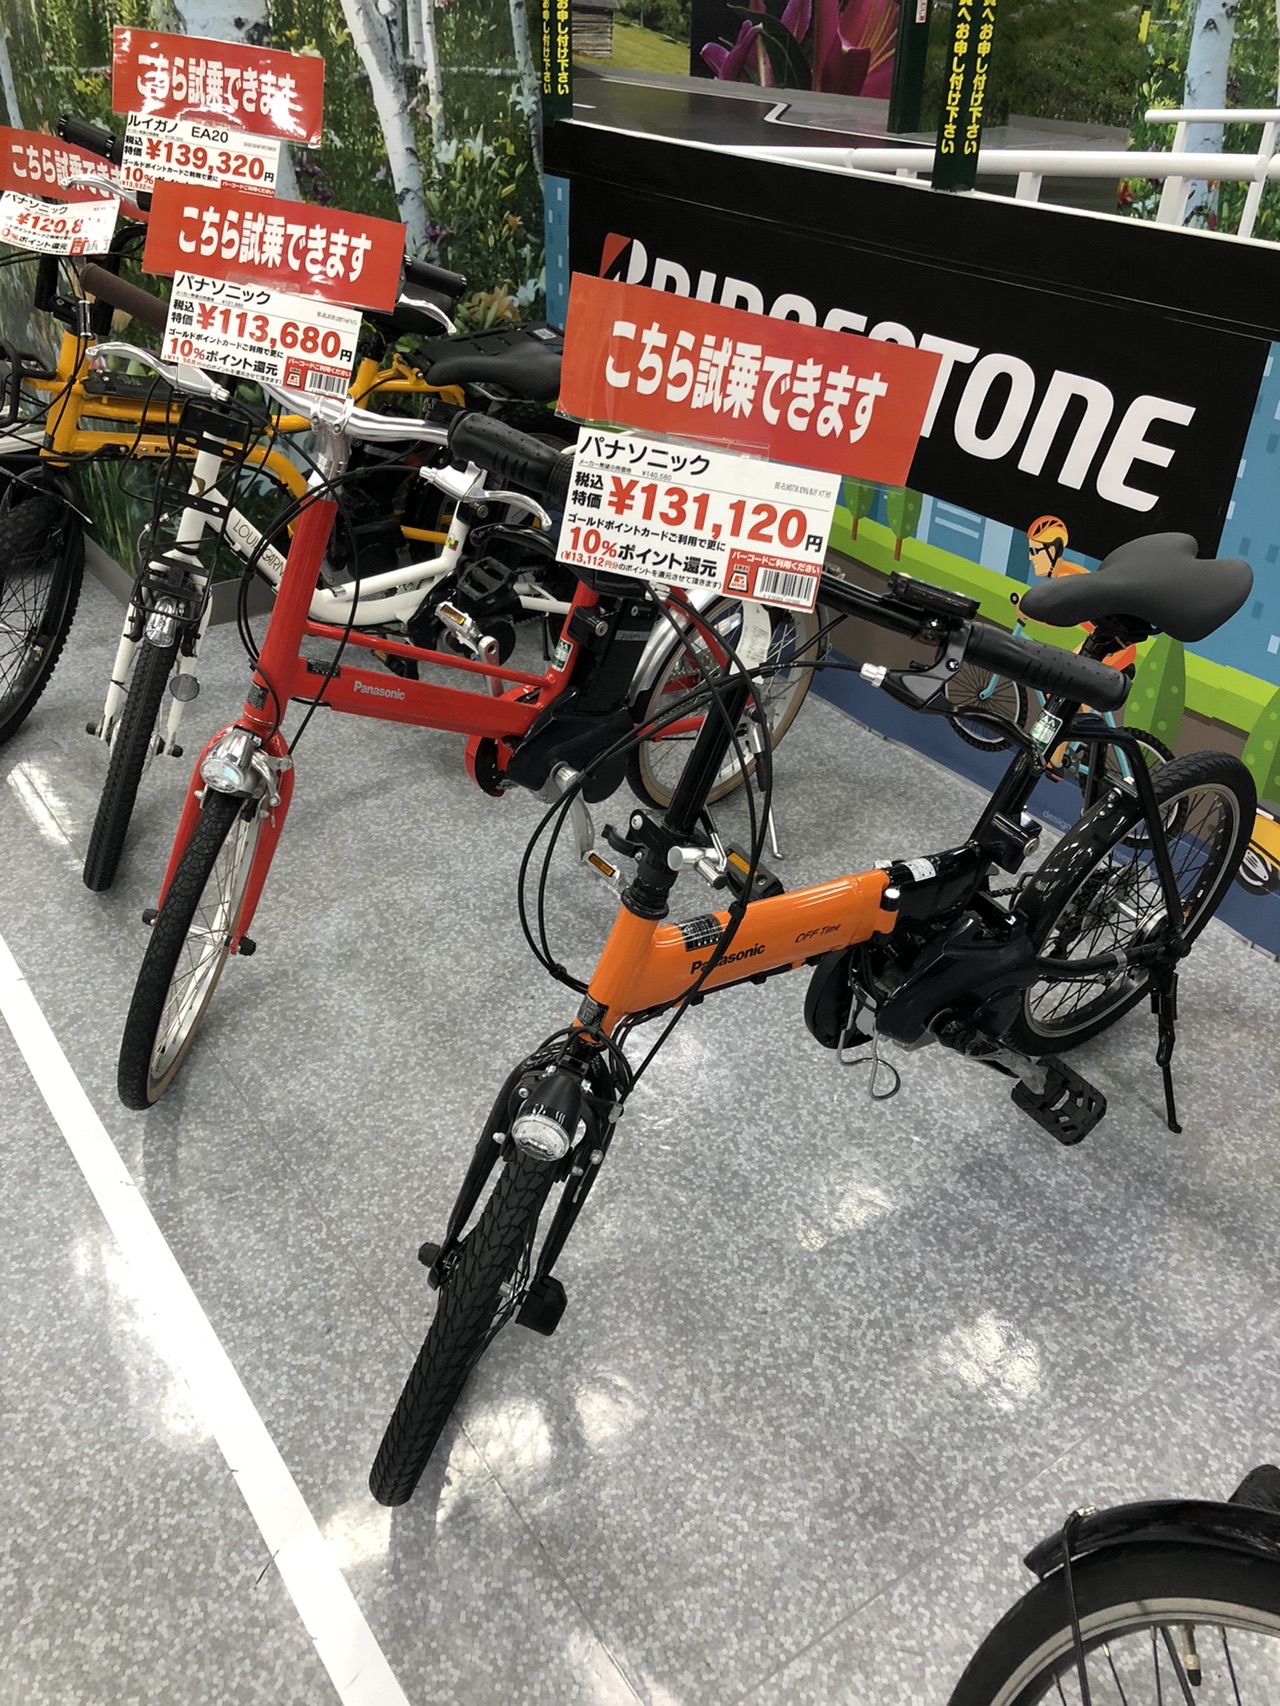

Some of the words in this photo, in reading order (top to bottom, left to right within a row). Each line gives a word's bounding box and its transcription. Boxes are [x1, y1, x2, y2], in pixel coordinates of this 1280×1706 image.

[556, 0, 569, 95] お申し付け下さい
[125, 135, 143, 146] 税込
[127, 114, 178, 134] ルイガノ
[191, 126, 229, 143] EA20
[124, 146, 143, 157] 特価
[11, 144, 122, 201] こちら試乗できま
[5, 193, 68, 215] パナソニック
[1, 227, 69, 250] 0%ポイント還元
[178, 205, 372, 283] こちら試乗できます
[177, 274, 271, 305] パナソニック
[171, 312, 193, 326] 特価
[173, 299, 195, 313] 税込
[168, 328, 284, 359] ゴールドポイントカードご利用で更に
[287, 357, 352, 378] バーコードご利用ください
[605, 320, 888, 444] こちら試乗できます
[154, 446, 195, 456] Panonic
[580, 435, 711, 475] パナソニック
[574, 471, 604, 490] 税込
[571, 489, 603, 510] 特価
[232, 518, 259, 549] LOUI
[567, 513, 726, 552] ゴールドポイントカードご利用で更に
[560, 550, 722, 590] (¥13,112円分のポイントを還元させて頂きます)
[731, 551, 821, 574] バーコードご利用ください
[353, 680, 405, 700] Panasonic
[690, 942, 766, 975] Pasonic
